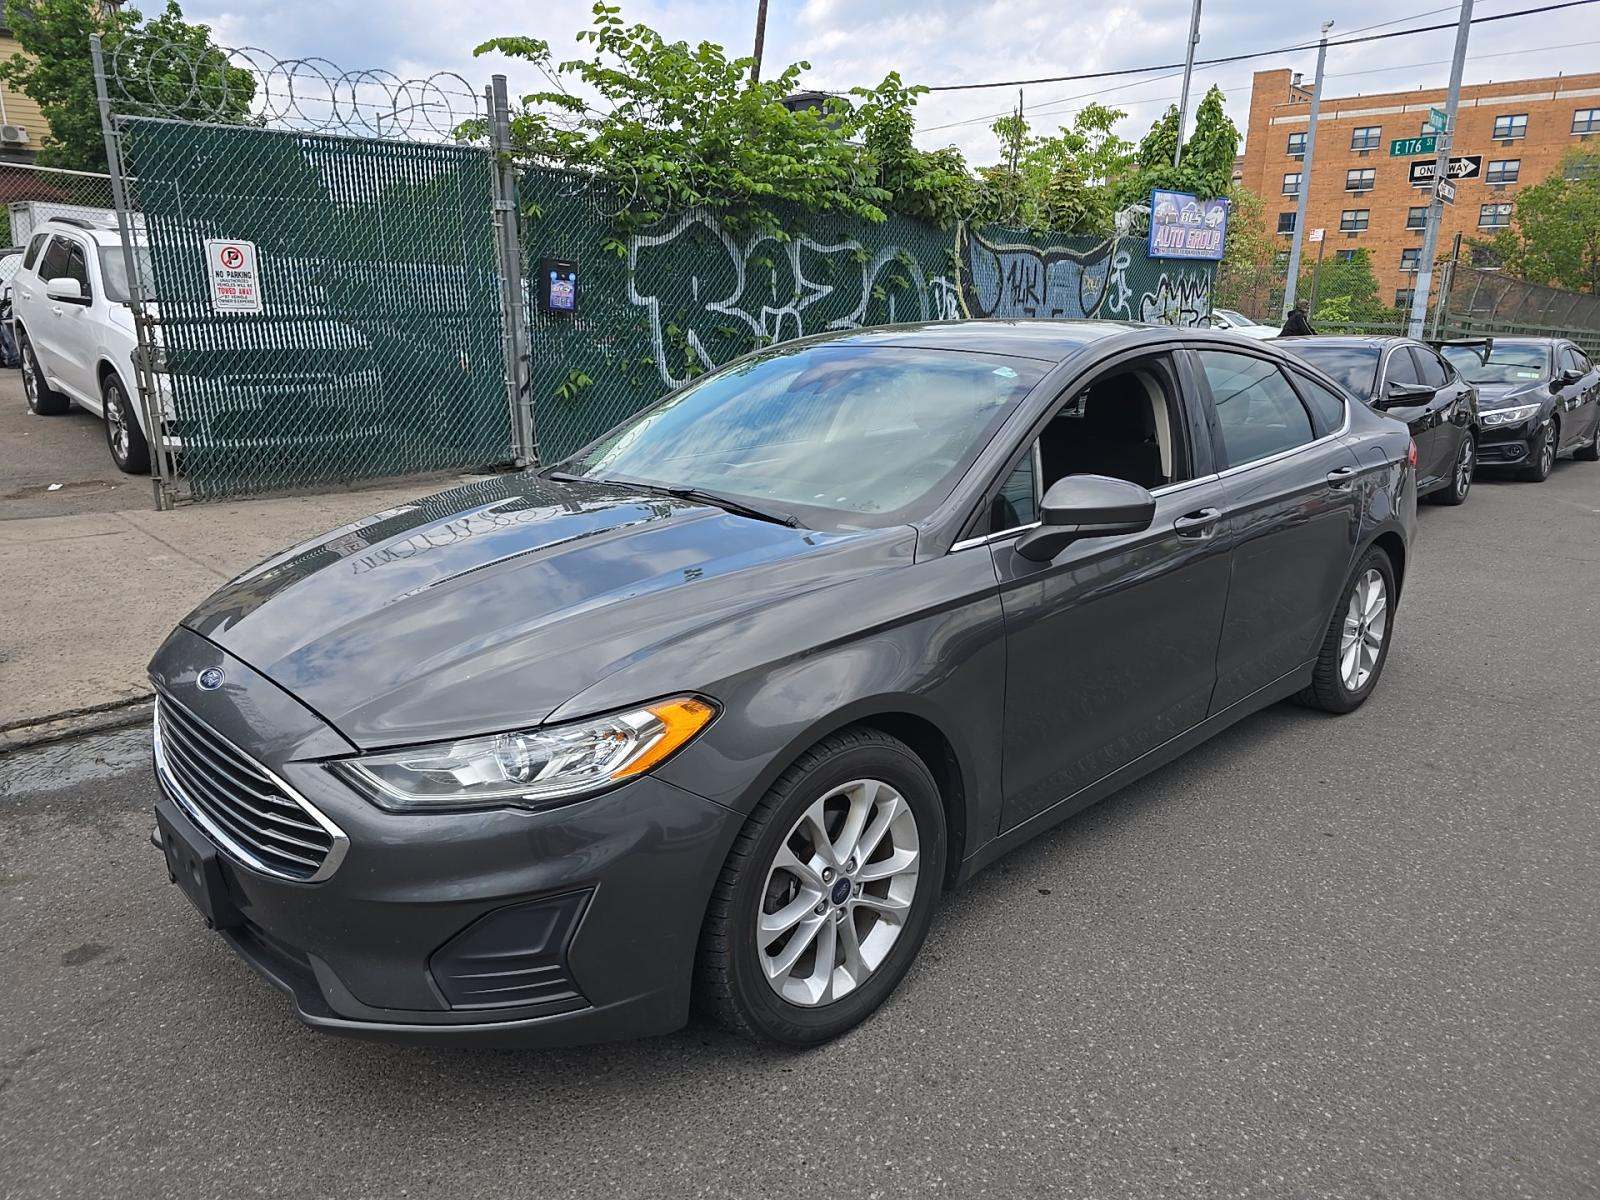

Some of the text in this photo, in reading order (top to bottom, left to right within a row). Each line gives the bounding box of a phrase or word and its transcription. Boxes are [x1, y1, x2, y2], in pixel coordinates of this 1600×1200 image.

[1395, 141, 1402, 155] E
[1405, 139, 1423, 155] 176
[1448, 162, 1470, 173] WAY
[1154, 225, 1221, 250] AUTO GROUP
[218, 287, 236, 295] TOWED
